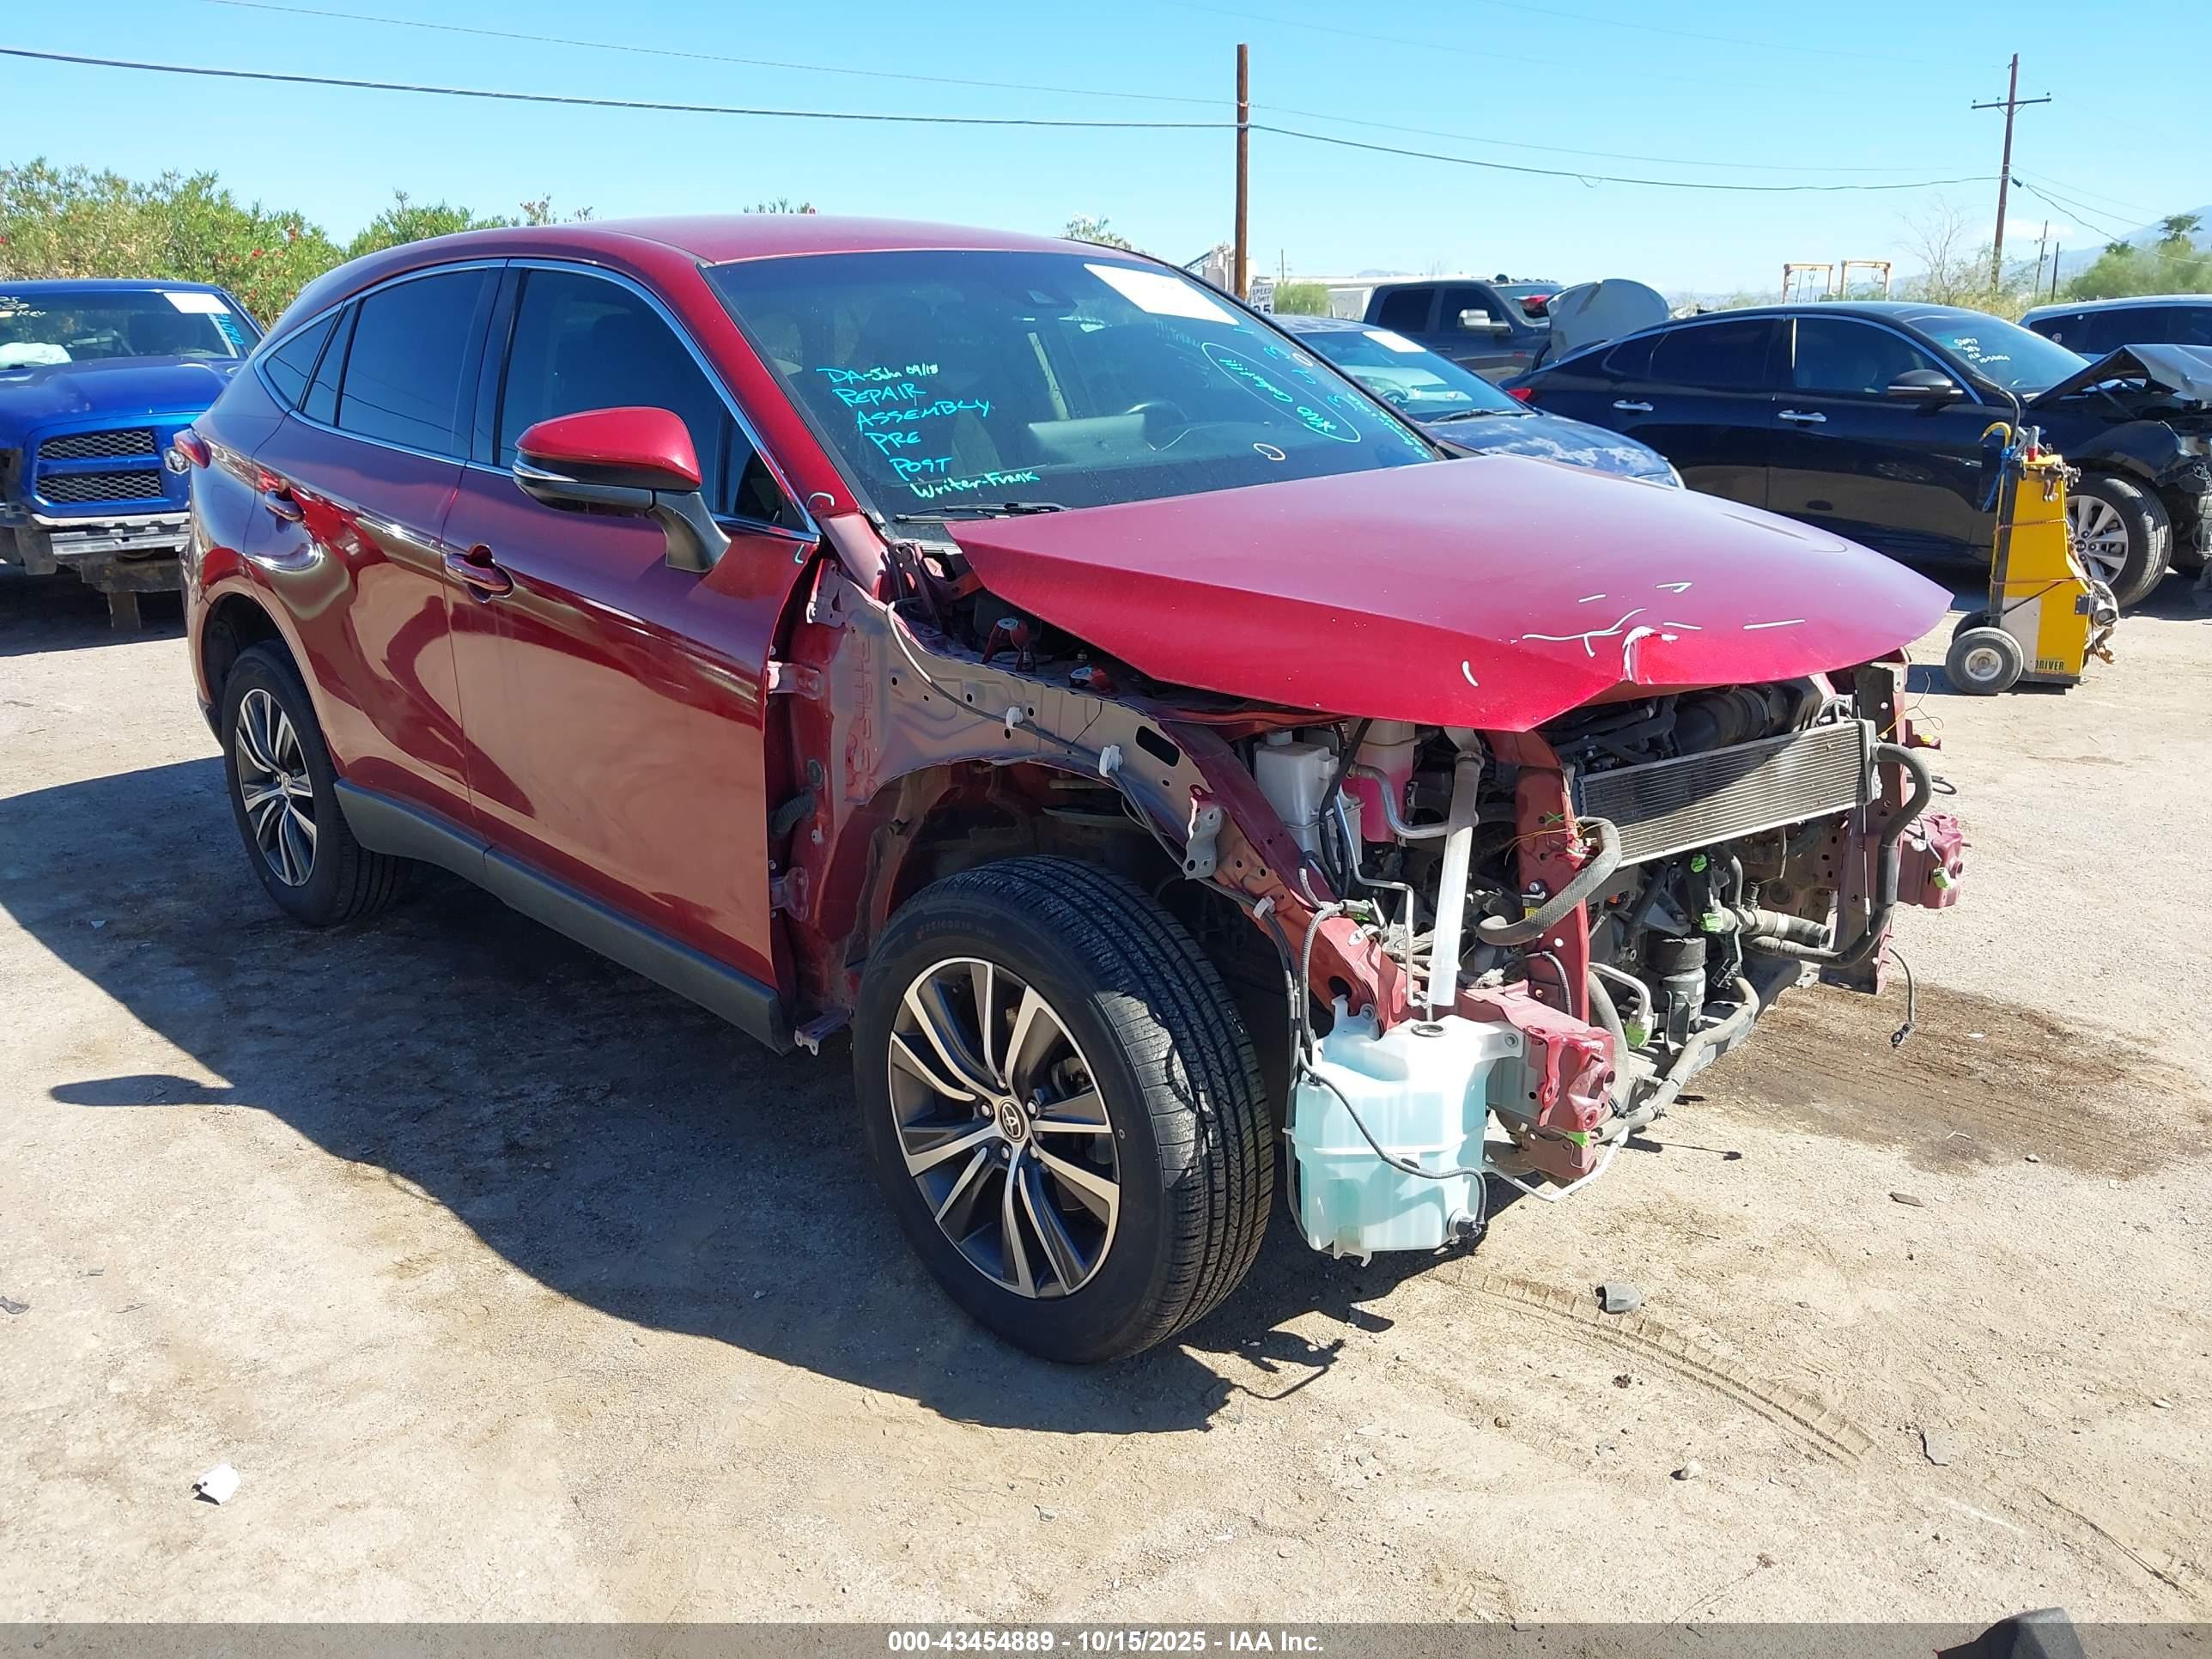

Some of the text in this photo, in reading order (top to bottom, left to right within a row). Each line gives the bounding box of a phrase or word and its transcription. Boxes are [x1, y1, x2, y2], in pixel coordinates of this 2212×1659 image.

[831, 383, 927, 408] REPAIR
[857, 398, 990, 432] ASSEMBLY
[864, 430, 921, 456] PRE
[889, 456, 953, 482] POST
